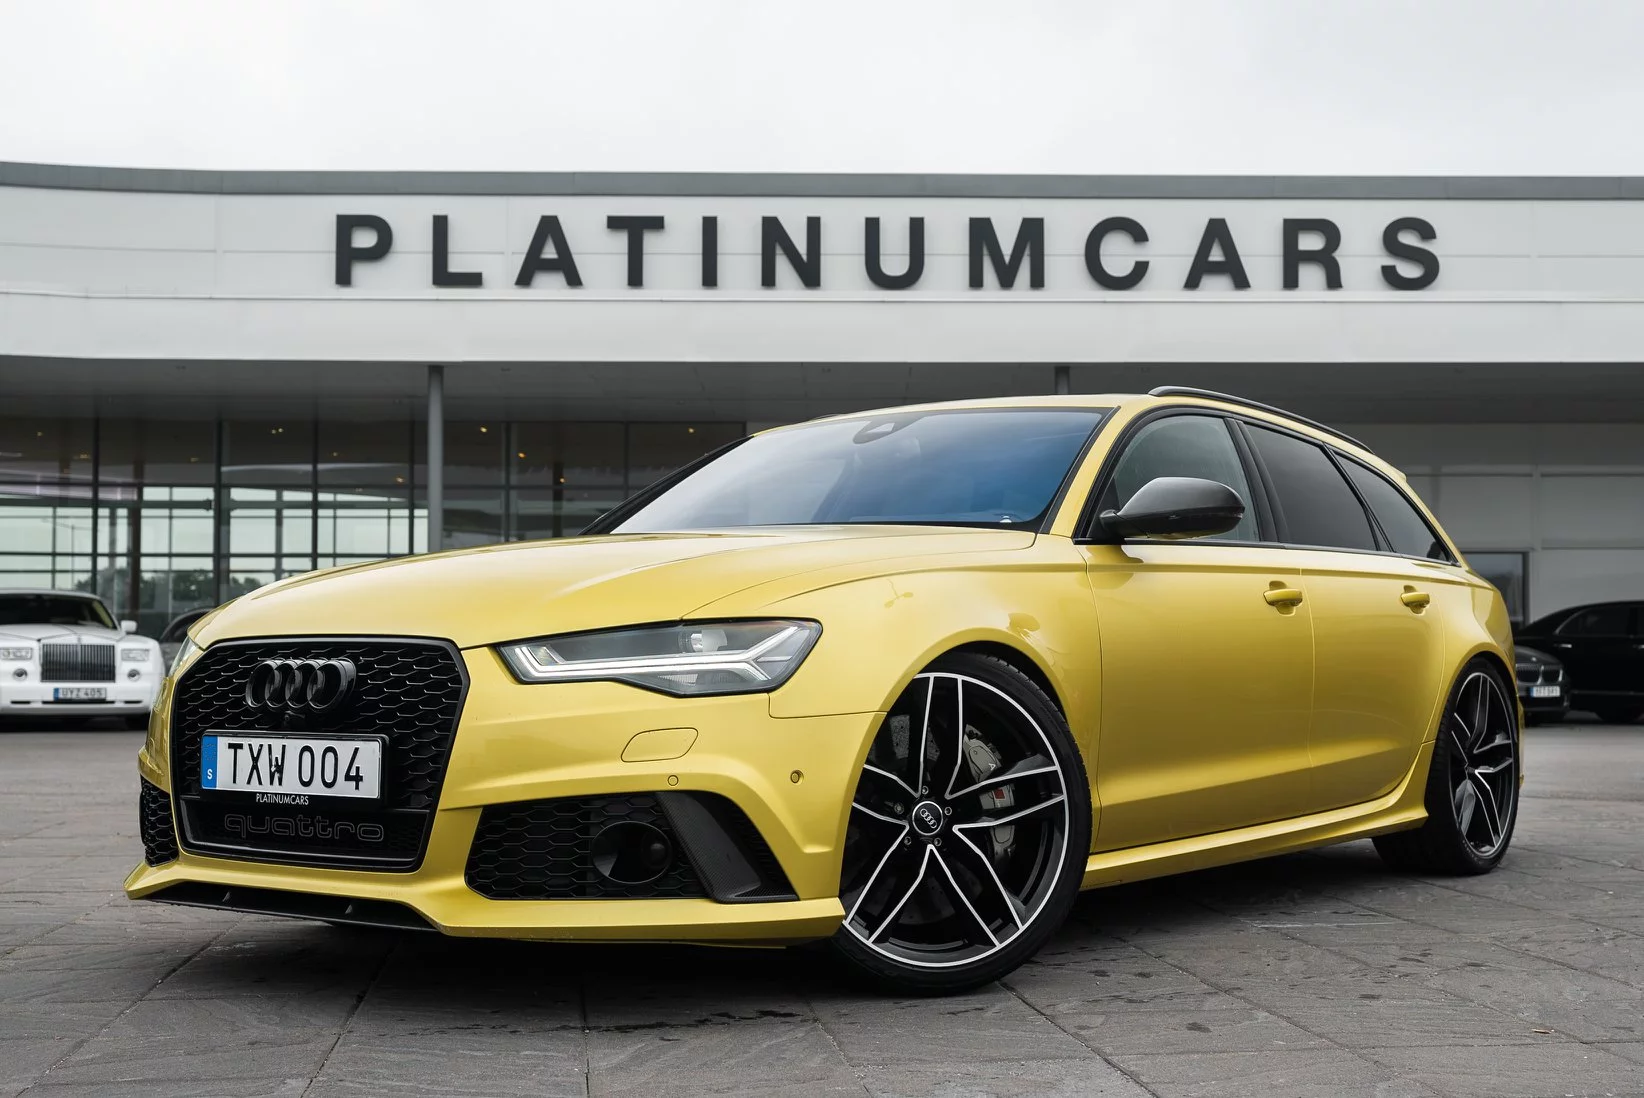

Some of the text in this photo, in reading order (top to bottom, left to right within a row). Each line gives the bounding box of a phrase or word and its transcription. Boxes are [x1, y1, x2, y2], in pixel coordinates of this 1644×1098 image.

[336, 214, 1441, 289] PLATINUMCARS
[207, 769, 213, 779] S
[227, 742, 363, 790] TXW 004
[255, 793, 309, 805] PLATINUMCARS
[224, 813, 384, 841] quattro
